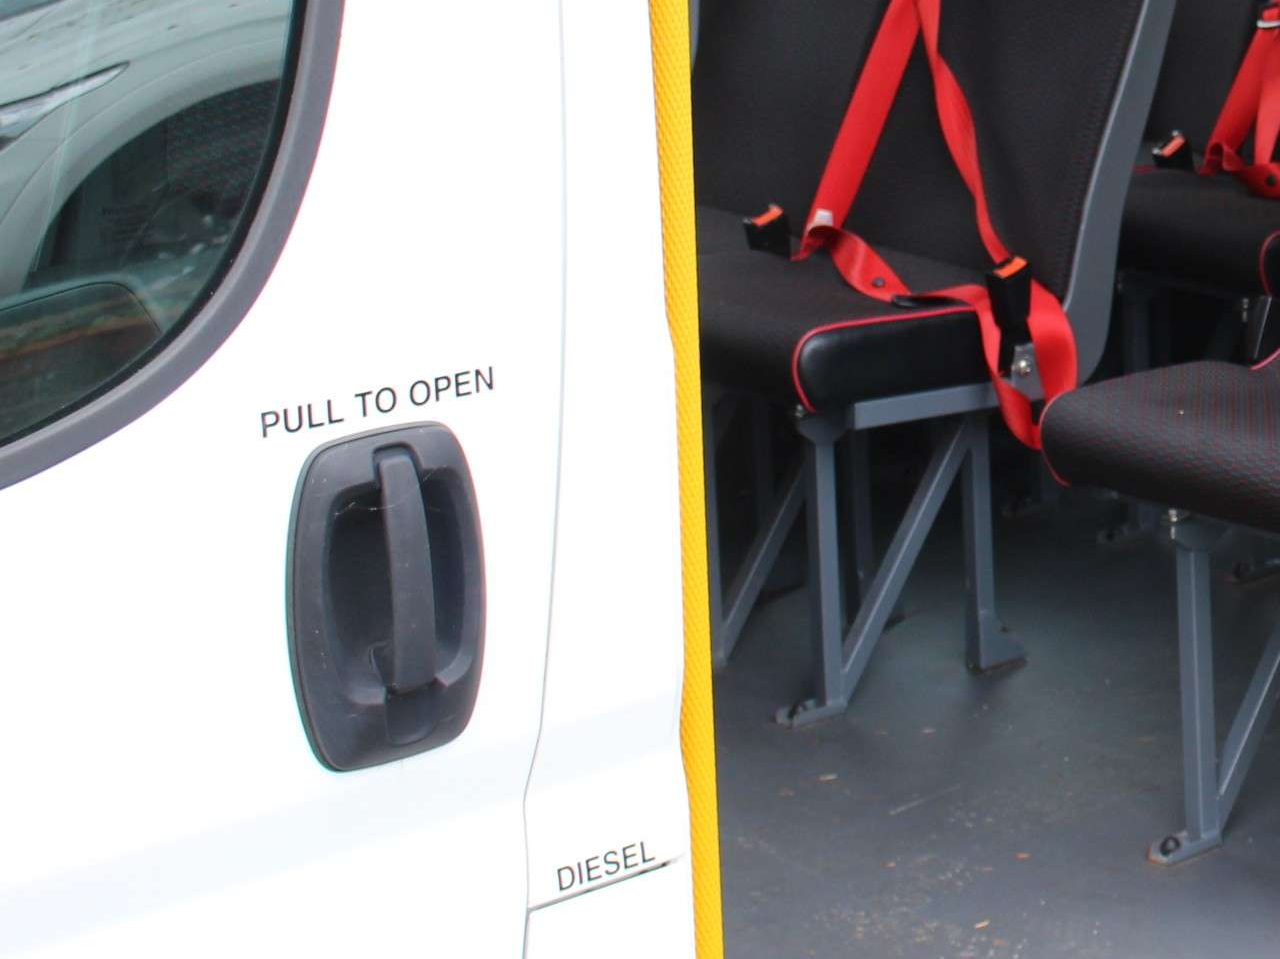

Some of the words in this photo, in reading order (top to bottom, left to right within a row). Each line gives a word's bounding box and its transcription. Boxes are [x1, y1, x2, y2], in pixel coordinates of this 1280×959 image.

[260, 399, 345, 438] PULL
[354, 386, 397, 417] TO
[409, 366, 494, 407] OPEN
[557, 841, 656, 891] DIESEL
